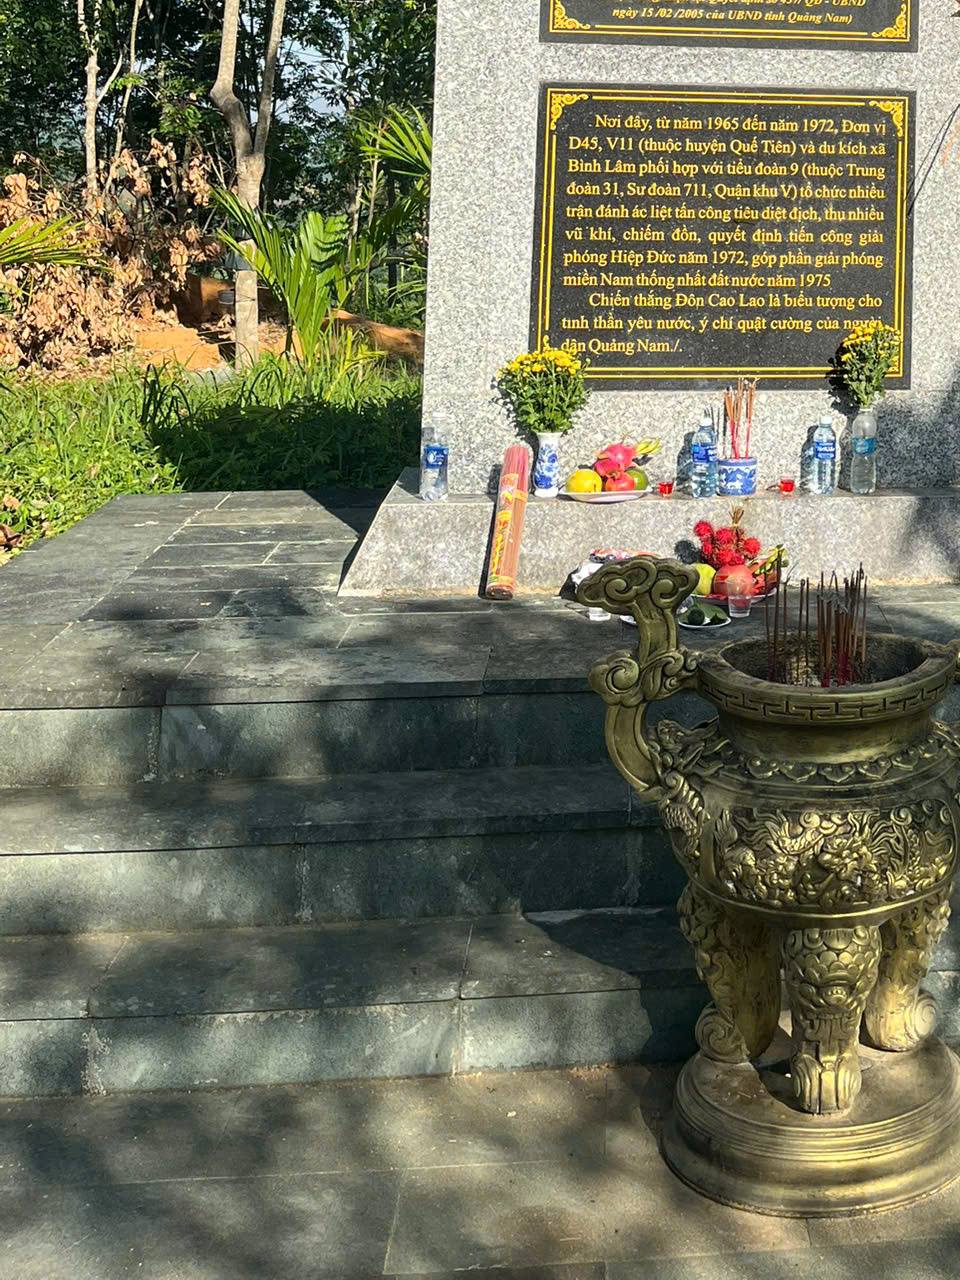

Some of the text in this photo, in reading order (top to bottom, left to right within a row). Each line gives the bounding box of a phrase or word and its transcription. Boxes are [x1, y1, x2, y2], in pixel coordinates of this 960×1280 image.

[596, 115, 886, 135] Nơi đây, từ năm 1965 đến năm 1972, Đơn vị
[569, 136, 602, 152] D45,
[607, 137, 632, 150] V11
[639, 138, 681, 153] (thuộc
[685, 139, 726, 155] huyện
[730, 137, 758, 155] Quế
[801, 141, 816, 154] và
[819, 142, 835, 155] du
[839, 142, 867, 155] kích
[870, 144, 886, 155] xã
[568, 158, 885, 180] Bình Lâm phối hợp với tiểu đoàn 9 (thuộc Trung
[567, 182, 886, 200] đoàn 31, Sư đoàn 711, Quận khu V) tổ chức nhiều
[566, 205, 593, 219] trận
[596, 204, 629, 218] đánh
[632, 205, 647, 218] ác
[650, 205, 672, 220] liệt
[675, 202, 696, 218] tấn
[698, 206, 732, 222] công
[734, 207, 759, 219] tiêu
[761, 207, 787, 222] diệt
[789, 207, 823, 222] địch,
[848, 206, 884, 221] nhiều
[566, 224, 883, 246] vũ khí, chiếm đồn, quyết định tiến công giải
[563, 248, 883, 268] phóng Hiệp Đức năm 1972, góp phần giải phóng
[563, 269, 830, 289] miền Nam thống nhất đất nước năm 1975
[589, 290, 630, 307] Chiến
[634, 290, 672, 310] thắng
[708, 294, 735, 307] Cao
[739, 294, 765, 308] Lao
[769, 294, 781, 307] là
[784, 291, 813, 307] biểu
[816, 296, 855, 310] tượng
[858, 294, 882, 307] cho
[594, 312, 623, 329] thần
[628, 316, 652, 333] yêu
[657, 316, 695, 331] nước,
[699, 316, 708, 333] ý
[712, 316, 733, 329] chí
[737, 317, 766, 333] quật
[770, 318, 812, 333] cường
[816, 318, 840, 329] của
[561, 339, 586, 354] dân
[588, 339, 634, 355] Quảng
